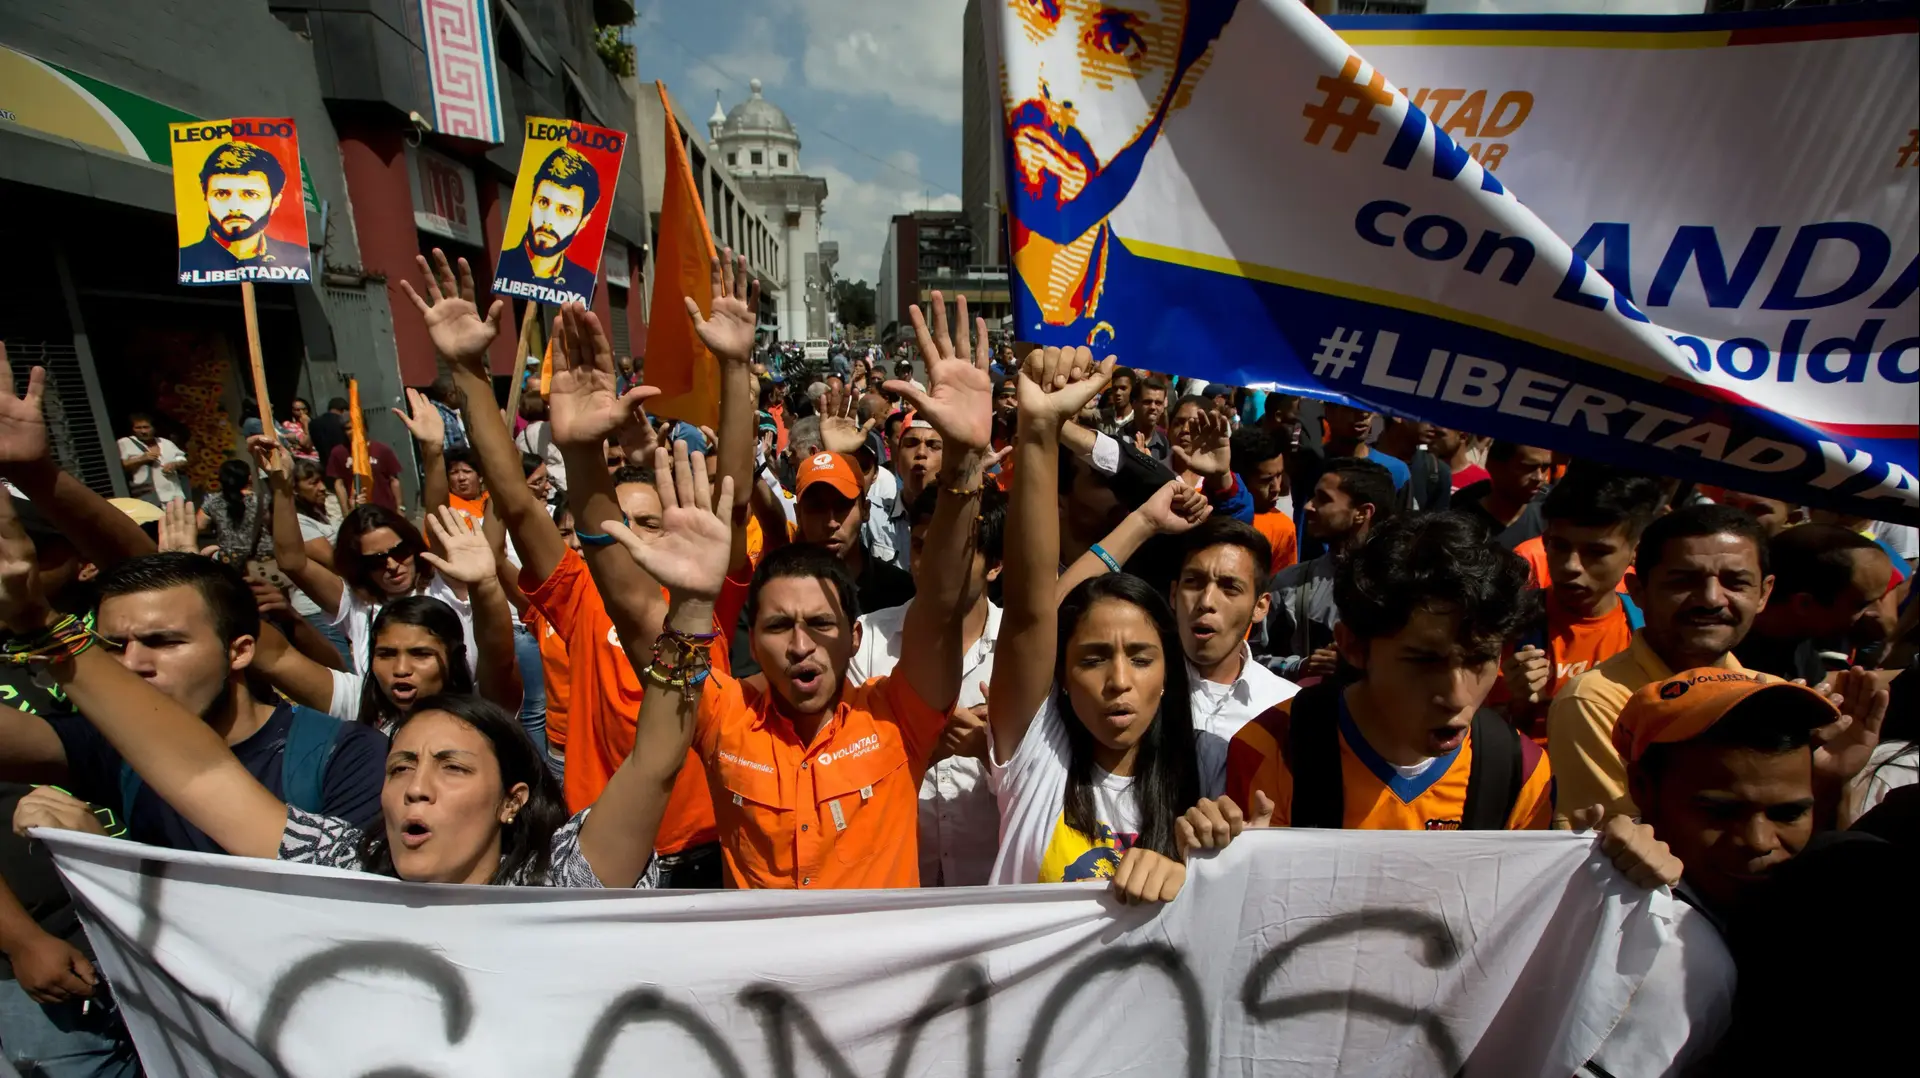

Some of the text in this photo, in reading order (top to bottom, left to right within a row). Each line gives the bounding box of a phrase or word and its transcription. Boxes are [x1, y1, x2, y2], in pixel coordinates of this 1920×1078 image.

[173, 122, 293, 143] LEOPOLDO
[528, 122, 621, 153] LEOPOLDO
[1355, 200, 1536, 286] con
[180, 265, 310, 283] #LIBERTADYA
[1311, 325, 1919, 509] #LIBERTADYA
[832, 733, 879, 761] VOLUNTAD
[852, 743, 880, 760] POPULAR
